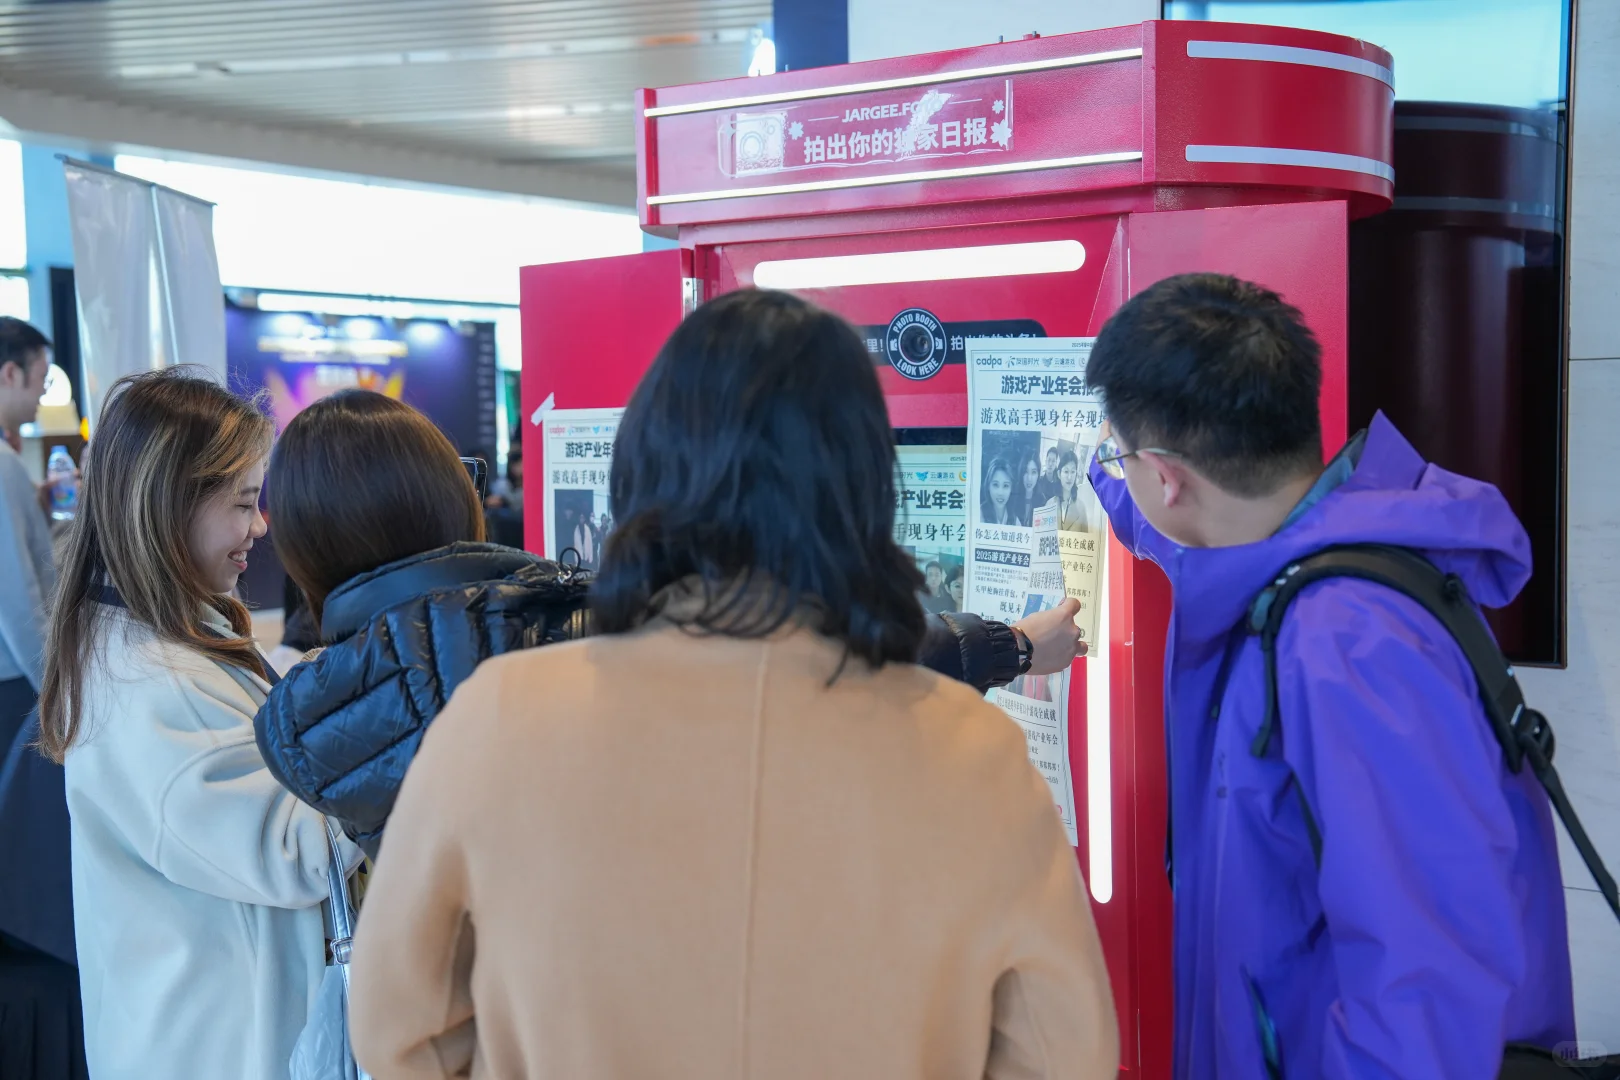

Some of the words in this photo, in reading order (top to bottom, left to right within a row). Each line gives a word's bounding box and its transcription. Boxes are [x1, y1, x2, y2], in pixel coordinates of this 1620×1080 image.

[892, 313, 914, 333] PHOTO
[915, 313, 938, 332] BOOTH
[863, 338, 884, 353] 里!
[896, 358, 917, 376] LOOK
[918, 357, 939, 376] HERE
[976, 354, 1002, 369] cadpa
[565, 441, 614, 459] 游戏产业年
[895, 489, 966, 510] 产业年会
[976, 550, 1030, 566] 2025游戏产业年会
